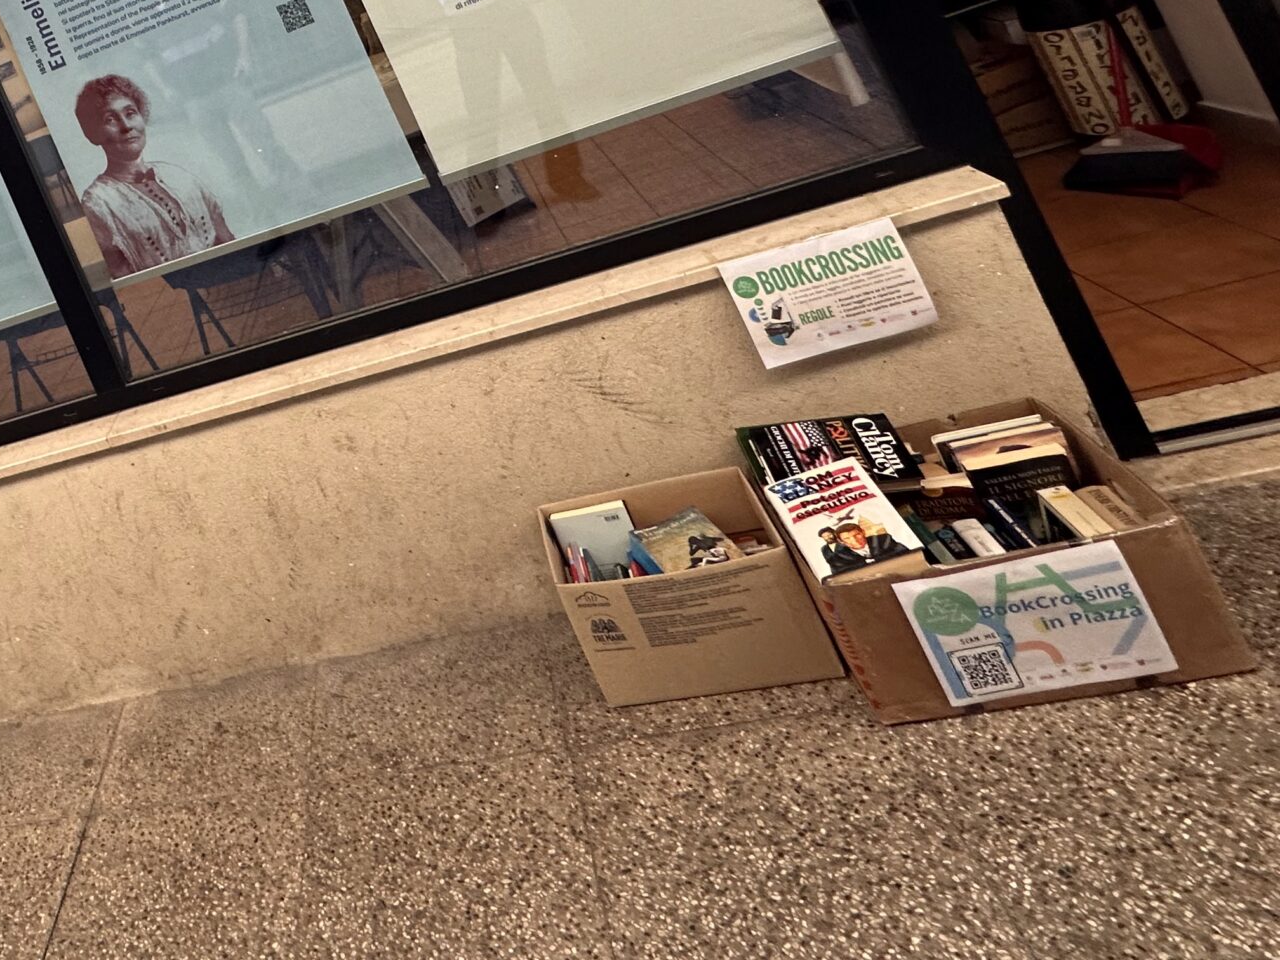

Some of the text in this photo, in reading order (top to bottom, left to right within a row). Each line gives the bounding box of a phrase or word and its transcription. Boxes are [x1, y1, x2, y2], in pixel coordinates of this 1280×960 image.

[25, 35, 36, 52] 1928
[35, 58, 46, 74] 1858
[755, 235, 904, 295] BOOKCROSSING
[799, 305, 836, 326] REGOLE
[769, 425, 785, 450] GIOCHI
[851, 416, 900, 479] Clancy
[874, 430, 905, 470] Tom
[783, 471, 855, 502] CLANCY
[800, 469, 834, 485] TOM
[1003, 472, 1064, 492] SIGNORE
[795, 491, 870, 521] esecutivo
[800, 486, 855, 510] Potere
[915, 495, 977, 509] TRADITORE
[931, 504, 967, 515] ROMA
[978, 580, 1134, 620] BookCrossing
[1040, 605, 1144, 631] in Piazza
[959, 632, 998, 646] SCAN ME
